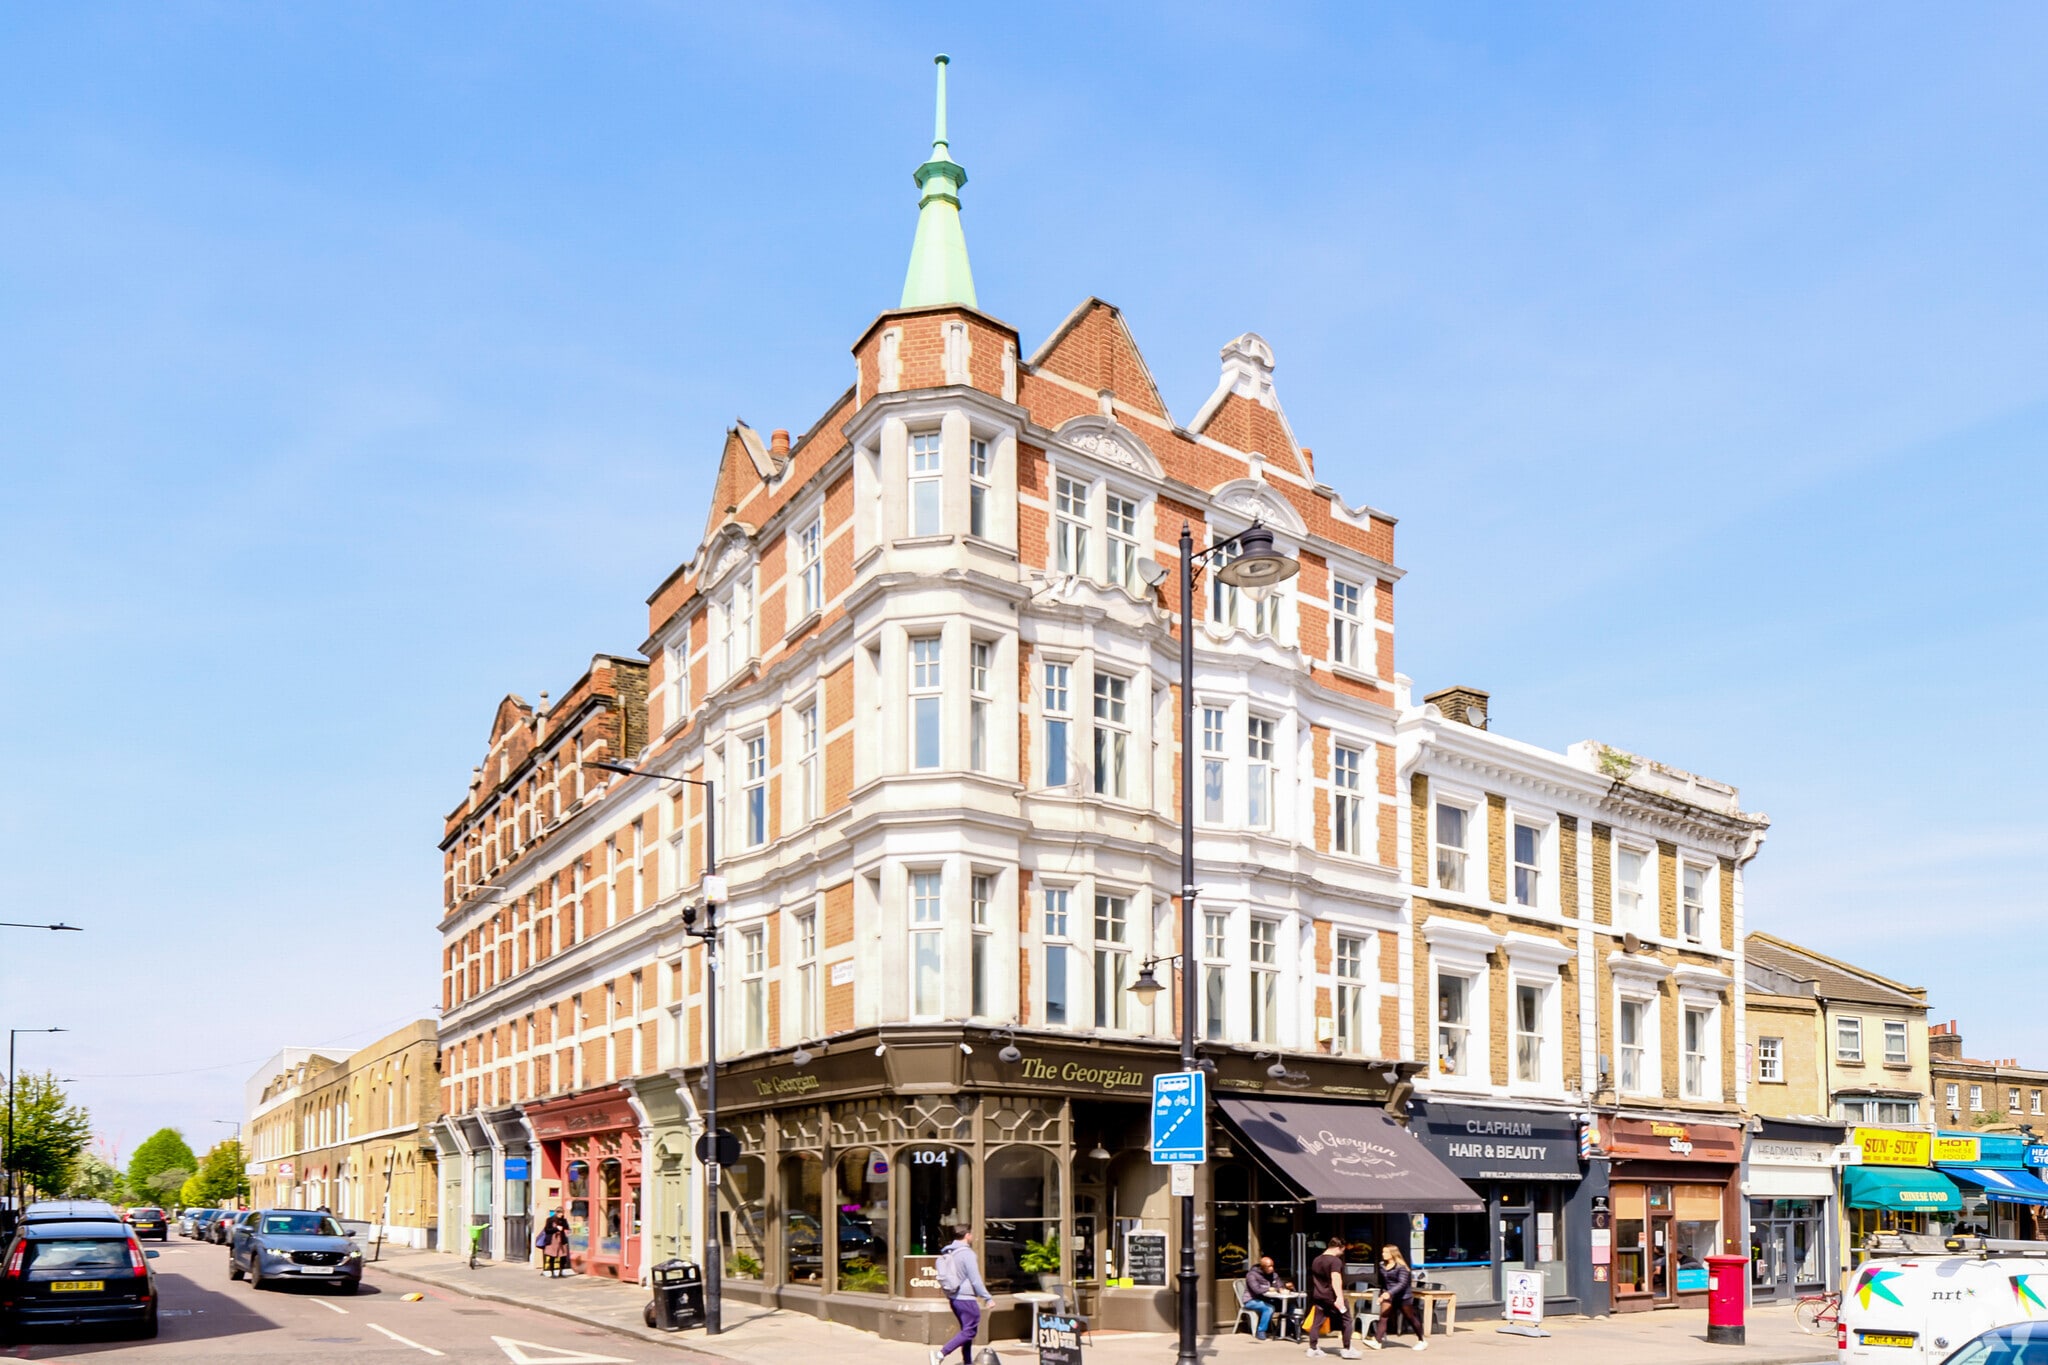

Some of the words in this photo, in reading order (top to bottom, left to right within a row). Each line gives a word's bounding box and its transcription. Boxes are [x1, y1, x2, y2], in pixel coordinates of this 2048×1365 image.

[1021, 1058, 1057, 1079] The
[1062, 1062, 1143, 1088] Georgian
[753, 1078, 773, 1096] The
[772, 1072, 820, 1094] Georgian
[1466, 1120, 1532, 1136] CLAPHAM
[1319, 1130, 1398, 1158] Georgian
[1669, 1137, 1693, 1157] Shop
[1939, 1139, 1973, 1147] HOT
[913, 1151, 948, 1167] 104
[1449, 1143, 1482, 1158] HAIR
[1484, 1144, 1494, 1158] &
[1496, 1145, 1547, 1160] BEAUTY
[1929, 1192, 1948, 1202] FOOD
[921, 1266, 938, 1276] Th
[1512, 1296, 1534, 1308] £13
[1932, 1289, 1962, 1300] nrt
